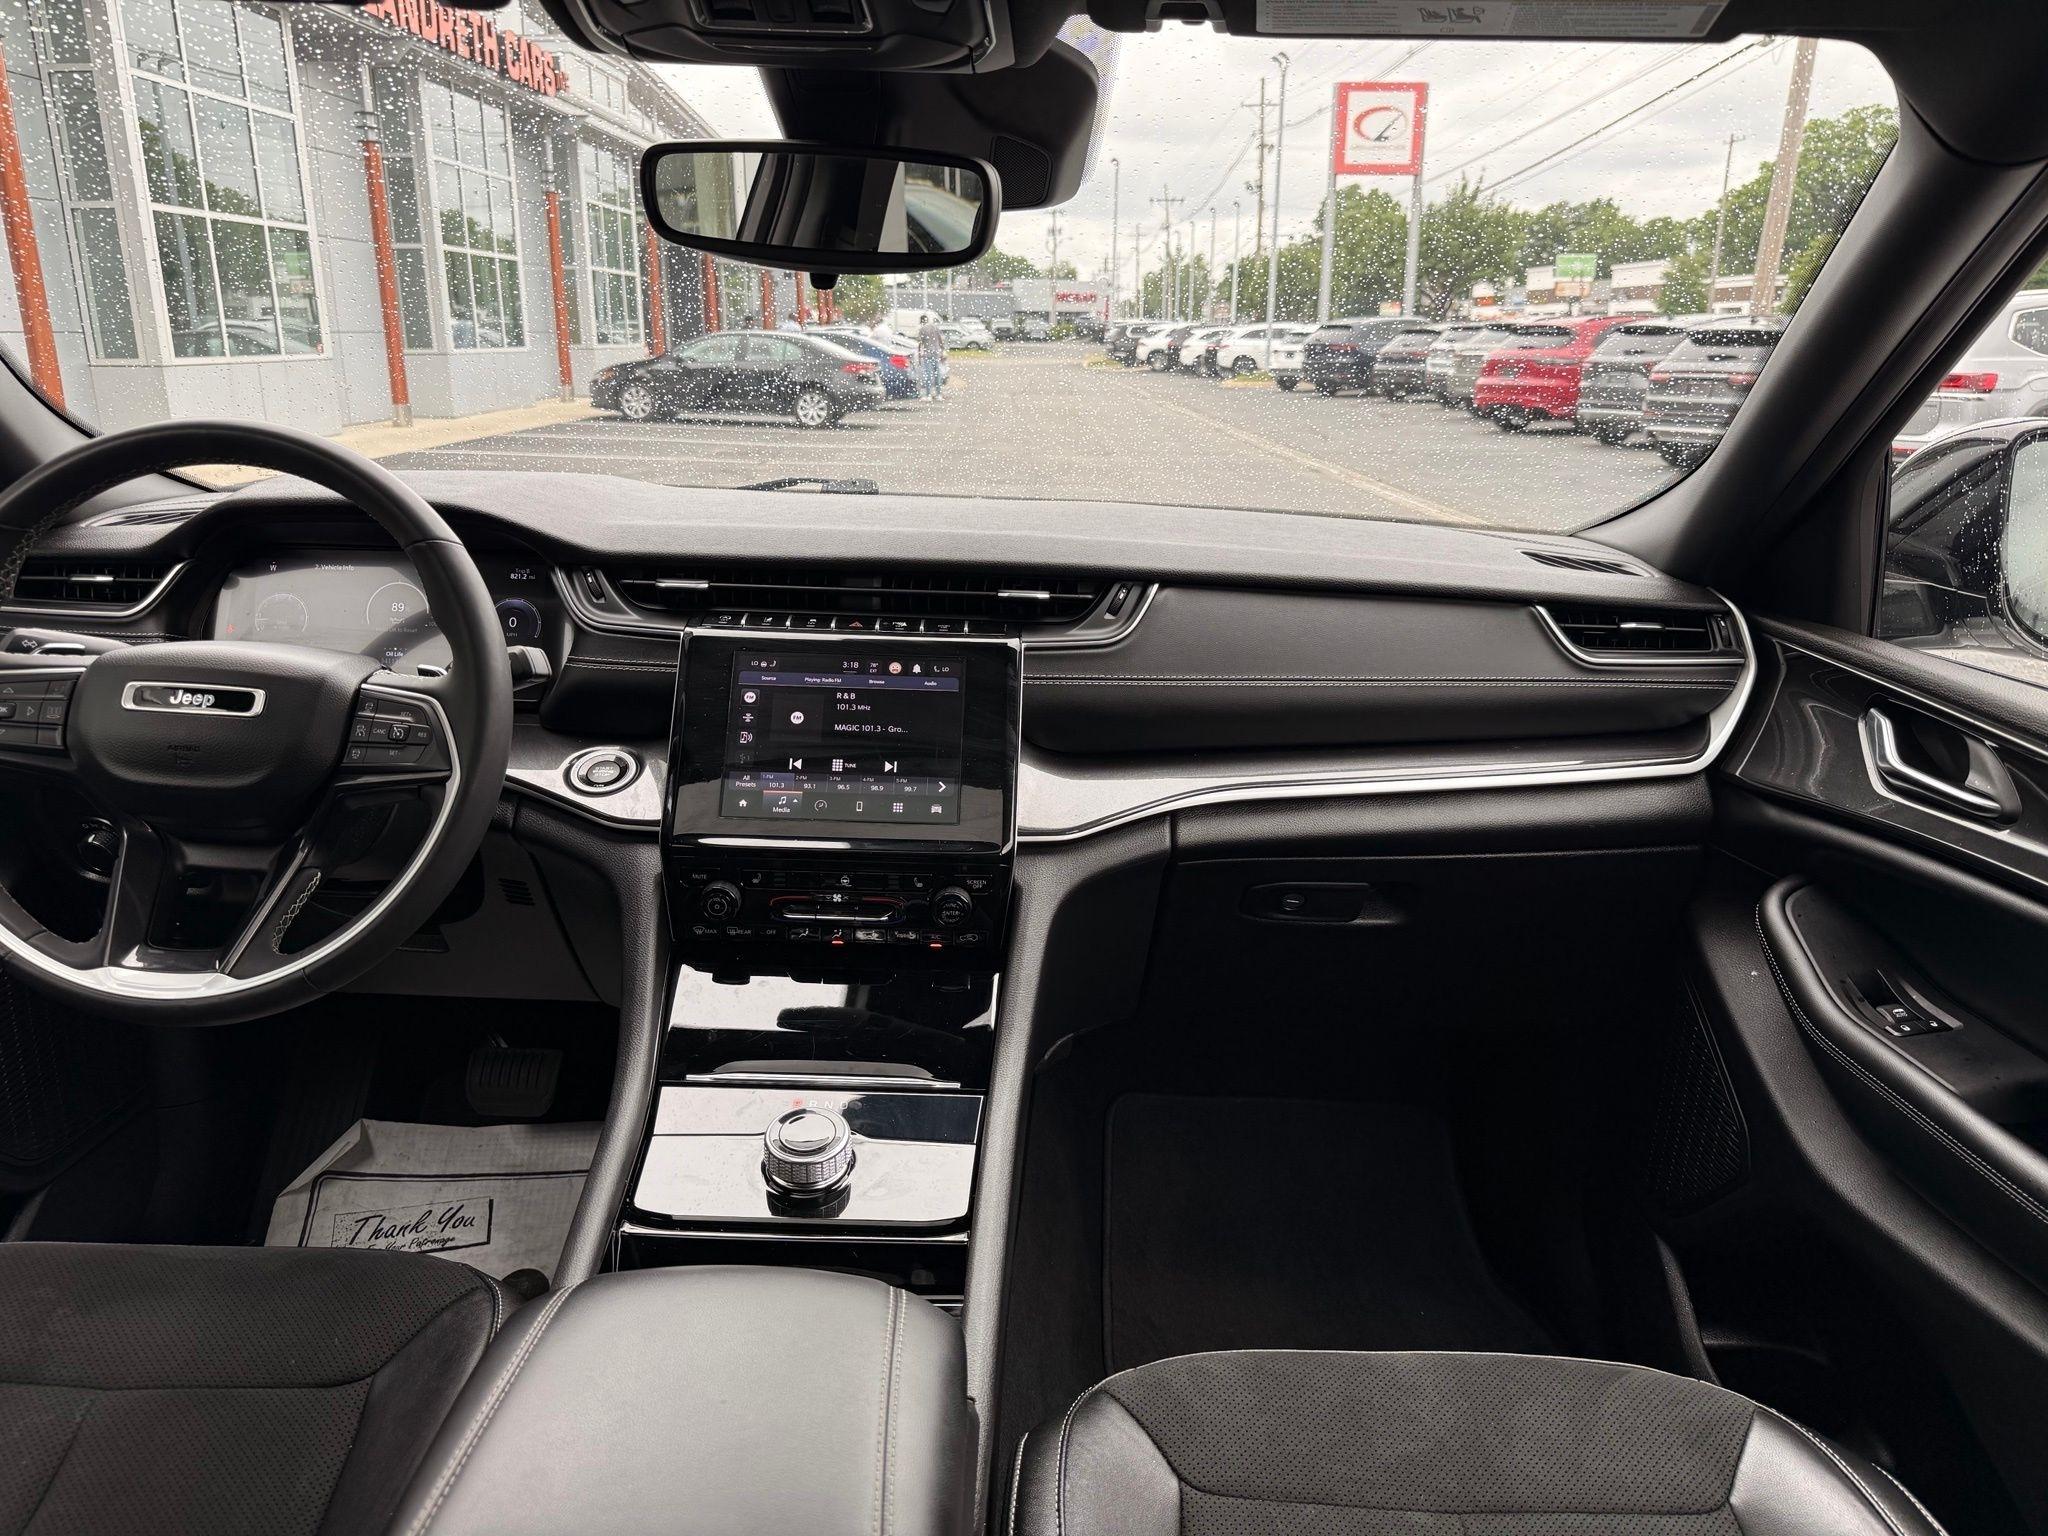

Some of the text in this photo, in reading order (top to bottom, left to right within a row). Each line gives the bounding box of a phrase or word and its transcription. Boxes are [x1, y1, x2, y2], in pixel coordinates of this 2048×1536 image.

[362, 0, 500, 72] ANDRETH
[504, 29, 557, 97] CARS
[391, 602, 405, 612] 89
[508, 616, 518, 629] 0
[842, 661, 860, 669] 3:18
[169, 689, 216, 709] Jeep
[836, 692, 856, 700] R & B
[836, 703, 857, 711] 101.3
[834, 724, 860, 732] MAGIC
[861, 724, 882, 733] 101.3
[772, 806, 791, 814] Media
[349, 1204, 476, 1246] Thank You
